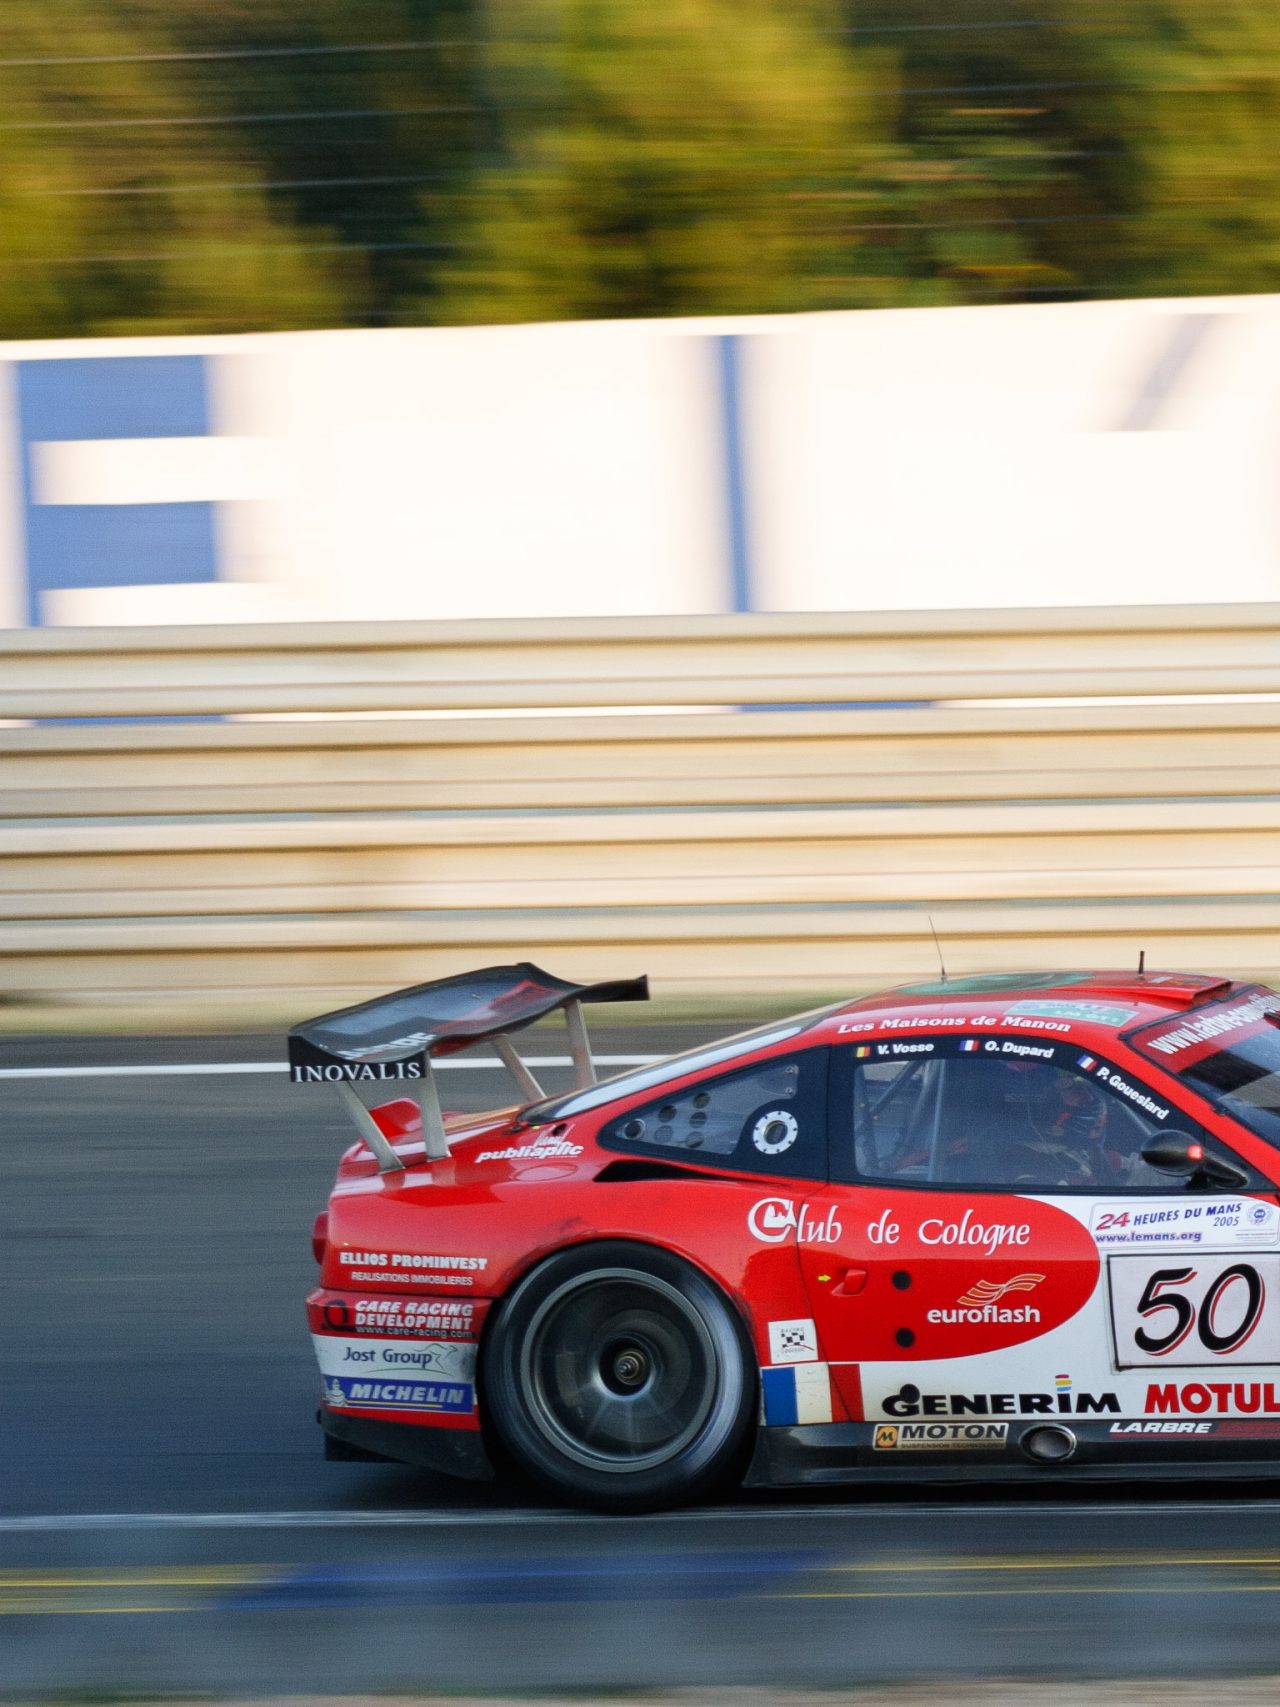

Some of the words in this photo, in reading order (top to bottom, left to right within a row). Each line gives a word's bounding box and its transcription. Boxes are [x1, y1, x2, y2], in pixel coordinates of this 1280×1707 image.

[837, 1022, 874, 1034] Les
[879, 1016, 966, 1030] Maisons
[971, 1015, 997, 1026] de
[1000, 1016, 1071, 1032] Manon
[877, 1044, 890, 1055] V.
[892, 1042, 935, 1053] Vosse
[984, 1041, 1000, 1052] O.
[1002, 1042, 1055, 1059] Dupard
[294, 1062, 421, 1083] INOVALIS
[1096, 1066, 1108, 1080] P.
[1108, 1075, 1170, 1120] Goueslard
[1095, 1211, 1130, 1231] 24
[1134, 1210, 1180, 1226] HEURES
[1184, 1207, 1202, 1219] DU
[1206, 1202, 1242, 1217] MANS
[1213, 1216, 1240, 1227] 2005
[747, 1197, 843, 1243] Club
[867, 1208, 901, 1244] de
[918, 1208, 1031, 1256] Cologne
[1095, 1231, 1203, 1243] www.lemans.org
[340, 1252, 388, 1266] ELLIOS
[391, 1254, 488, 1270] PROMINVEST
[355, 1300, 402, 1313] CARE
[404, 1302, 474, 1317] RACING
[926, 1305, 1041, 1323] euroflash
[1134, 1263, 1266, 1357] 50
[355, 1313, 473, 1329] DEVELOPMENT
[355, 1326, 473, 1339] www.care-racing.com
[343, 1347, 376, 1362] Jost
[382, 1349, 433, 1368] Group
[350, 1383, 465, 1404] MICHELIN
[902, 1424, 1006, 1438] MOTON
[1110, 1422, 1213, 1433] LARBRE
